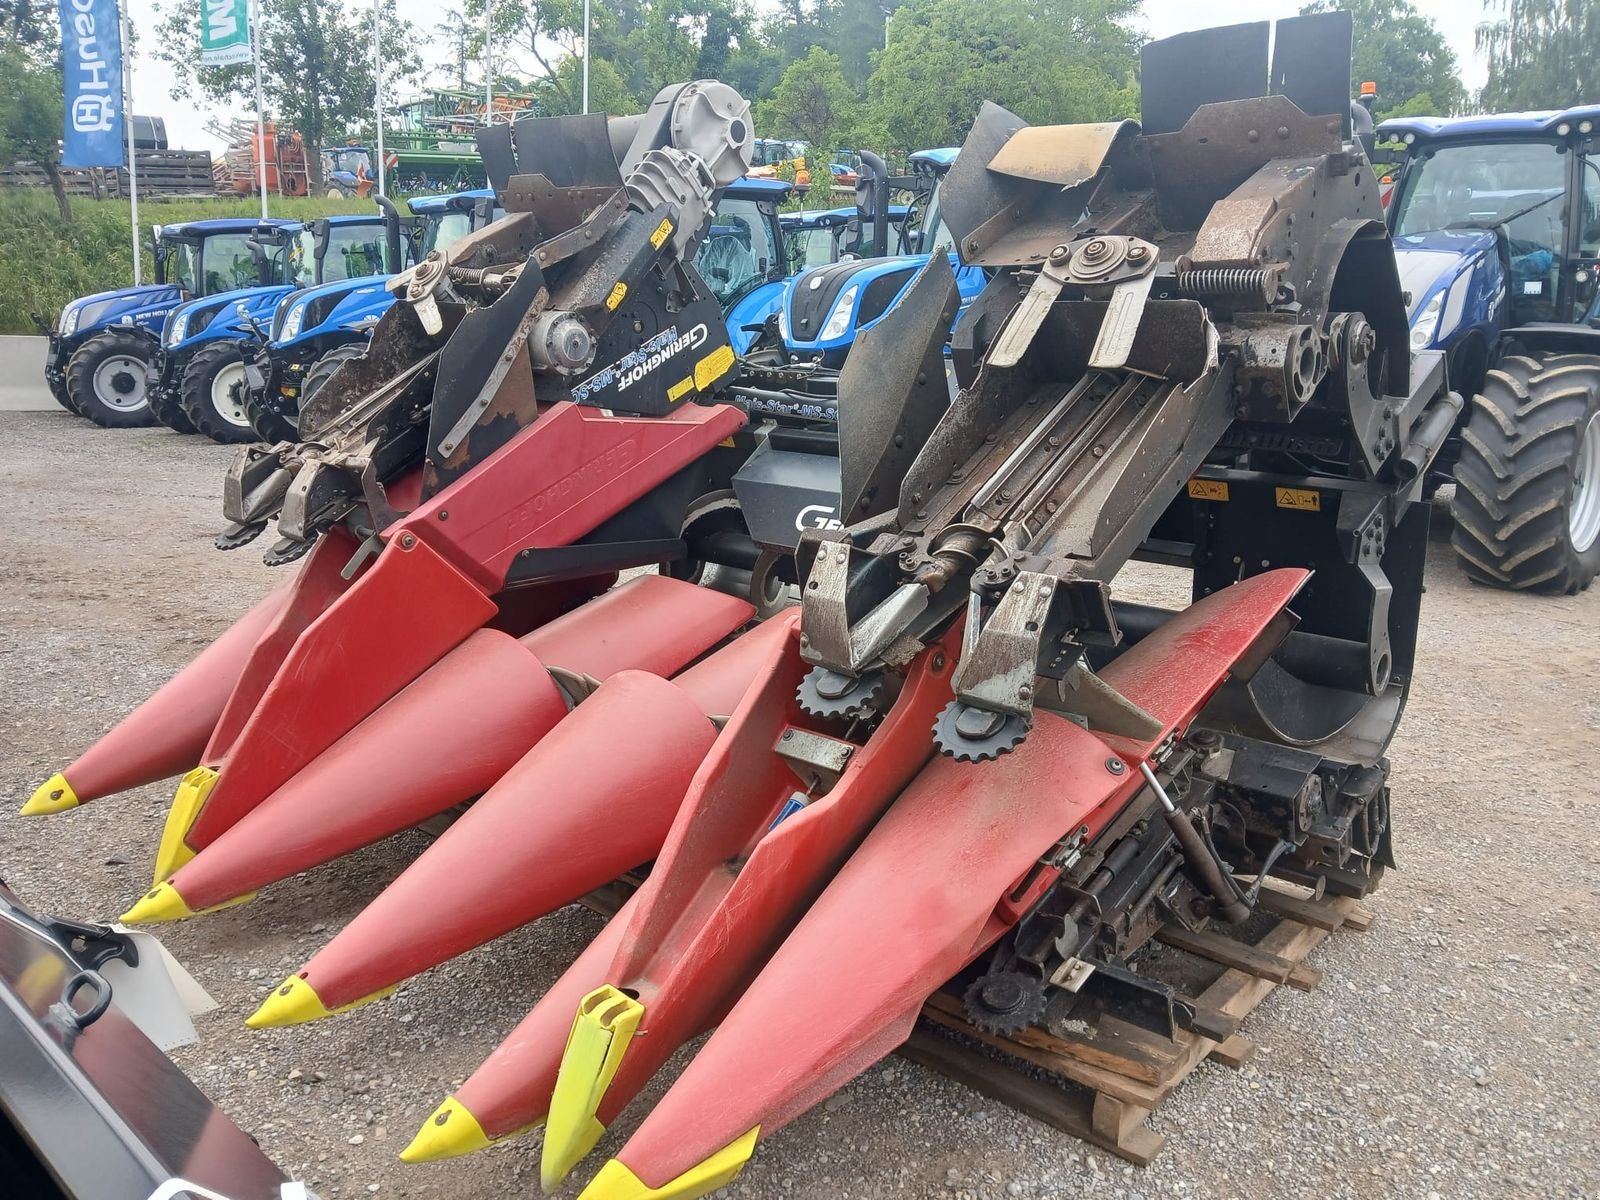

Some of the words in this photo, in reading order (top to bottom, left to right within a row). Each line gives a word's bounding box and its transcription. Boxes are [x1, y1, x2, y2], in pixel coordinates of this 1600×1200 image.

[136, 312, 151, 321] NEW
[152, 309, 168, 318] HOLL
[618, 323, 708, 392] GERINGHOFF
[795, 505, 845, 531] GE
